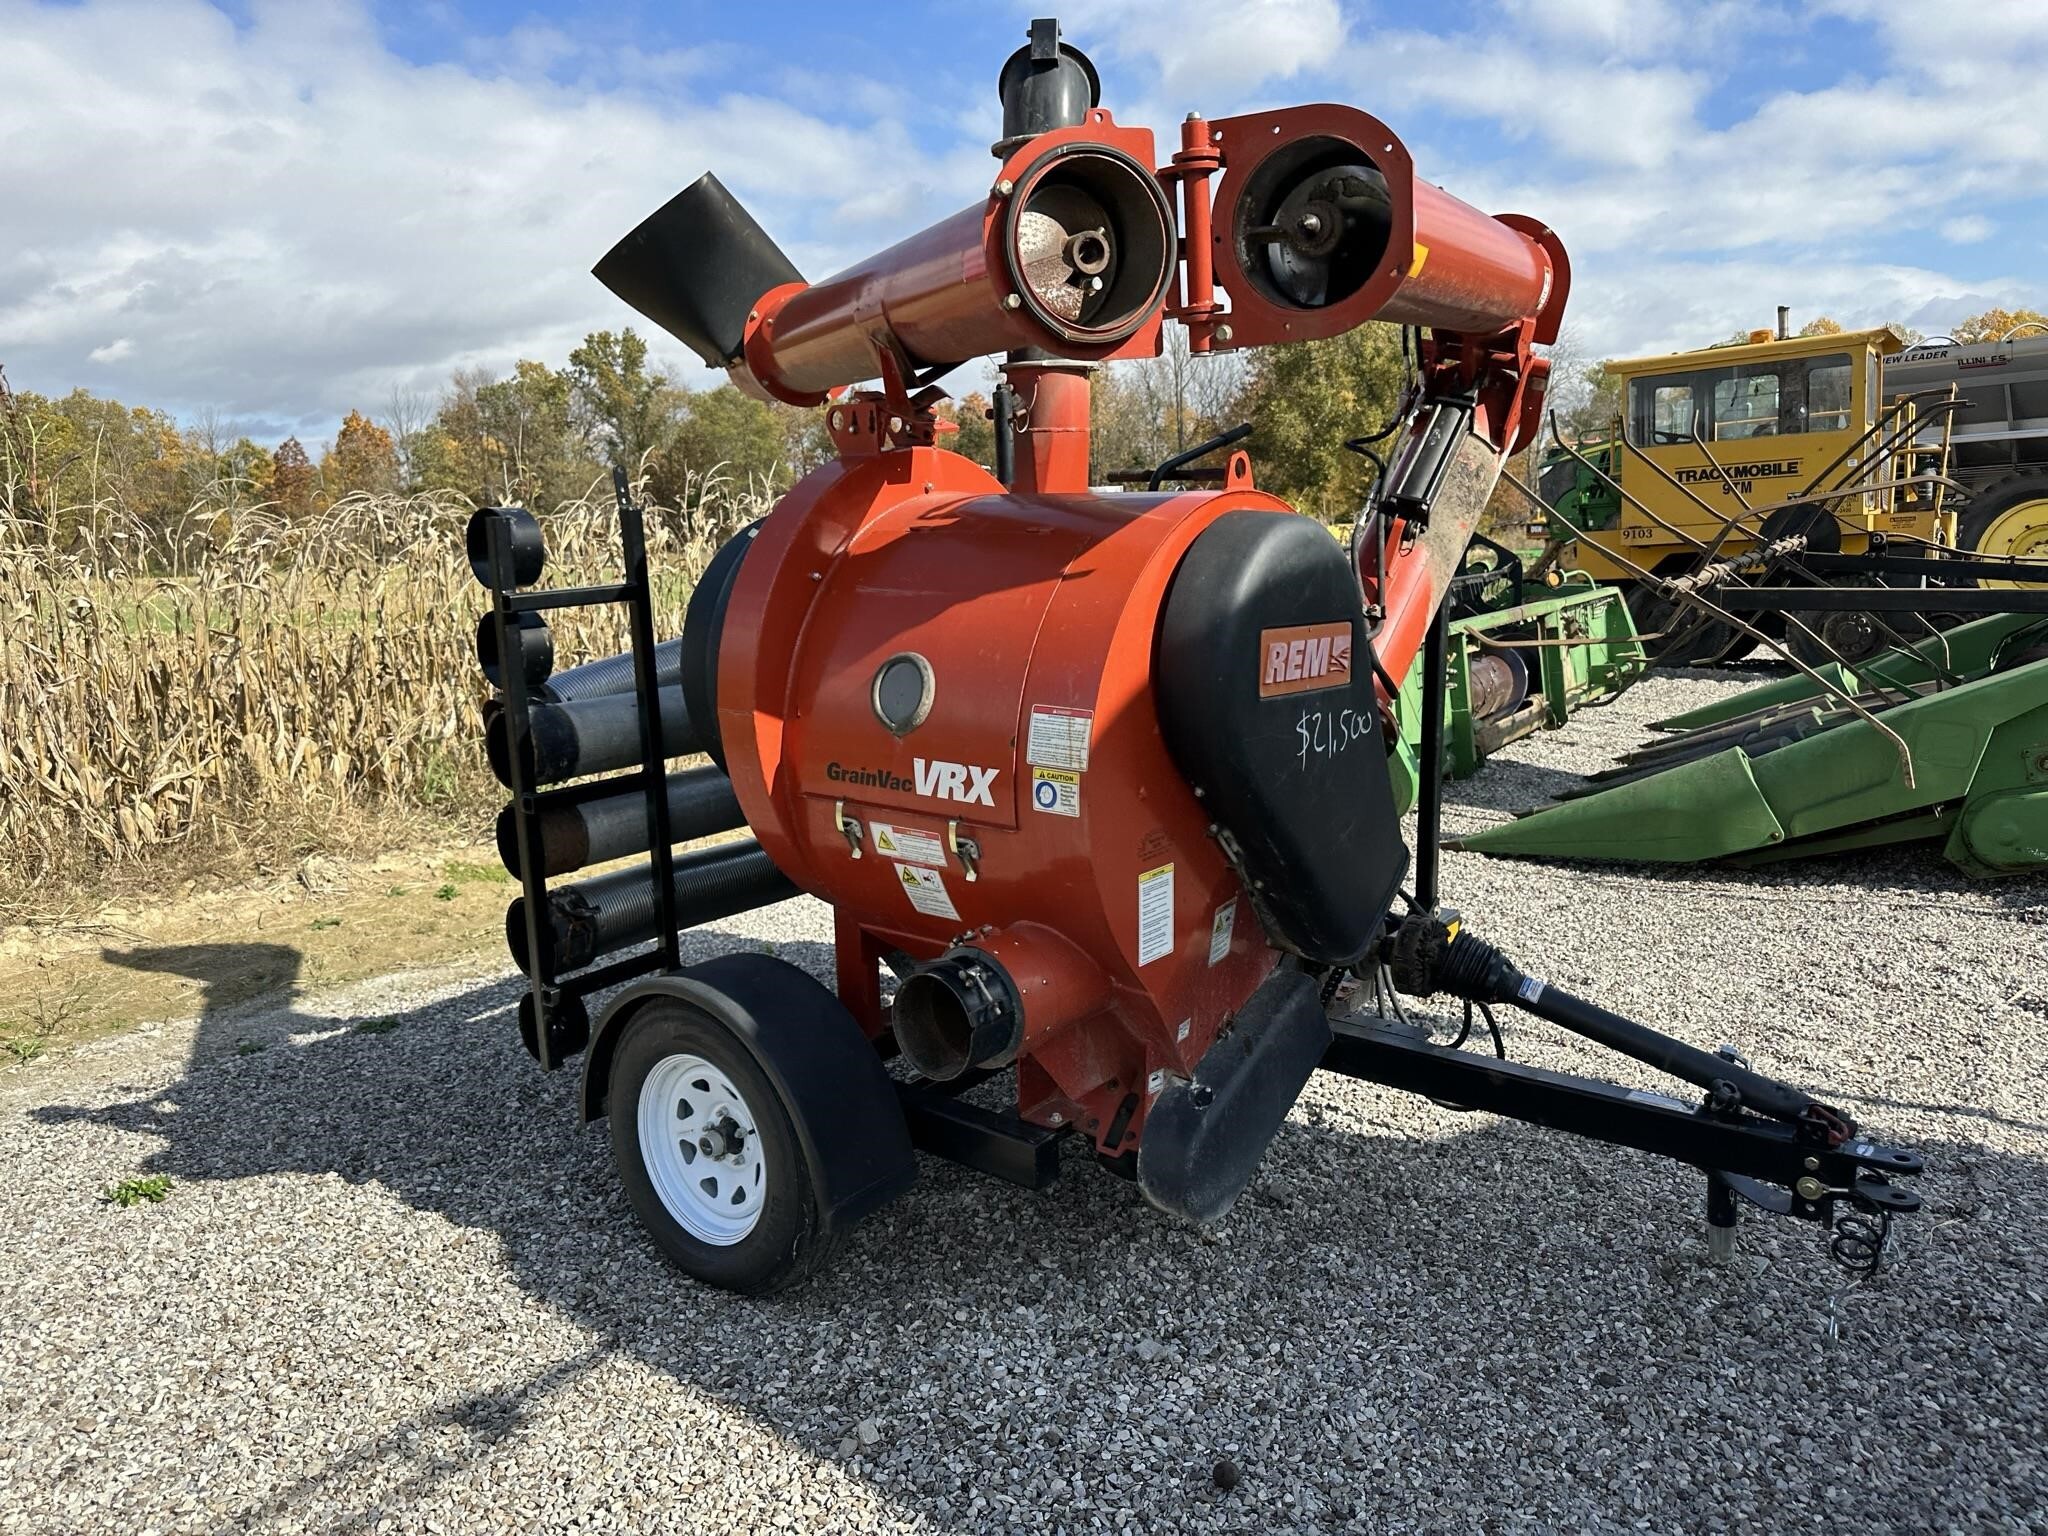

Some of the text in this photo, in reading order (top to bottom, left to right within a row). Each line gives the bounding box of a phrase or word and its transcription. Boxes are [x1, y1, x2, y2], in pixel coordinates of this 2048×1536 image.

[1905, 351, 1948, 362] LEADER
[1957, 357, 1985, 366] ILLINI
[1675, 462, 1798, 482] TRACKMOBILE
[1623, 529, 1653, 539] 9103
[1265, 637, 1330, 684] REM
[1296, 709, 1372, 771] $21,500
[827, 757, 1000, 807] GrainVac VRX
[1046, 772, 1074, 783] CAUTION
